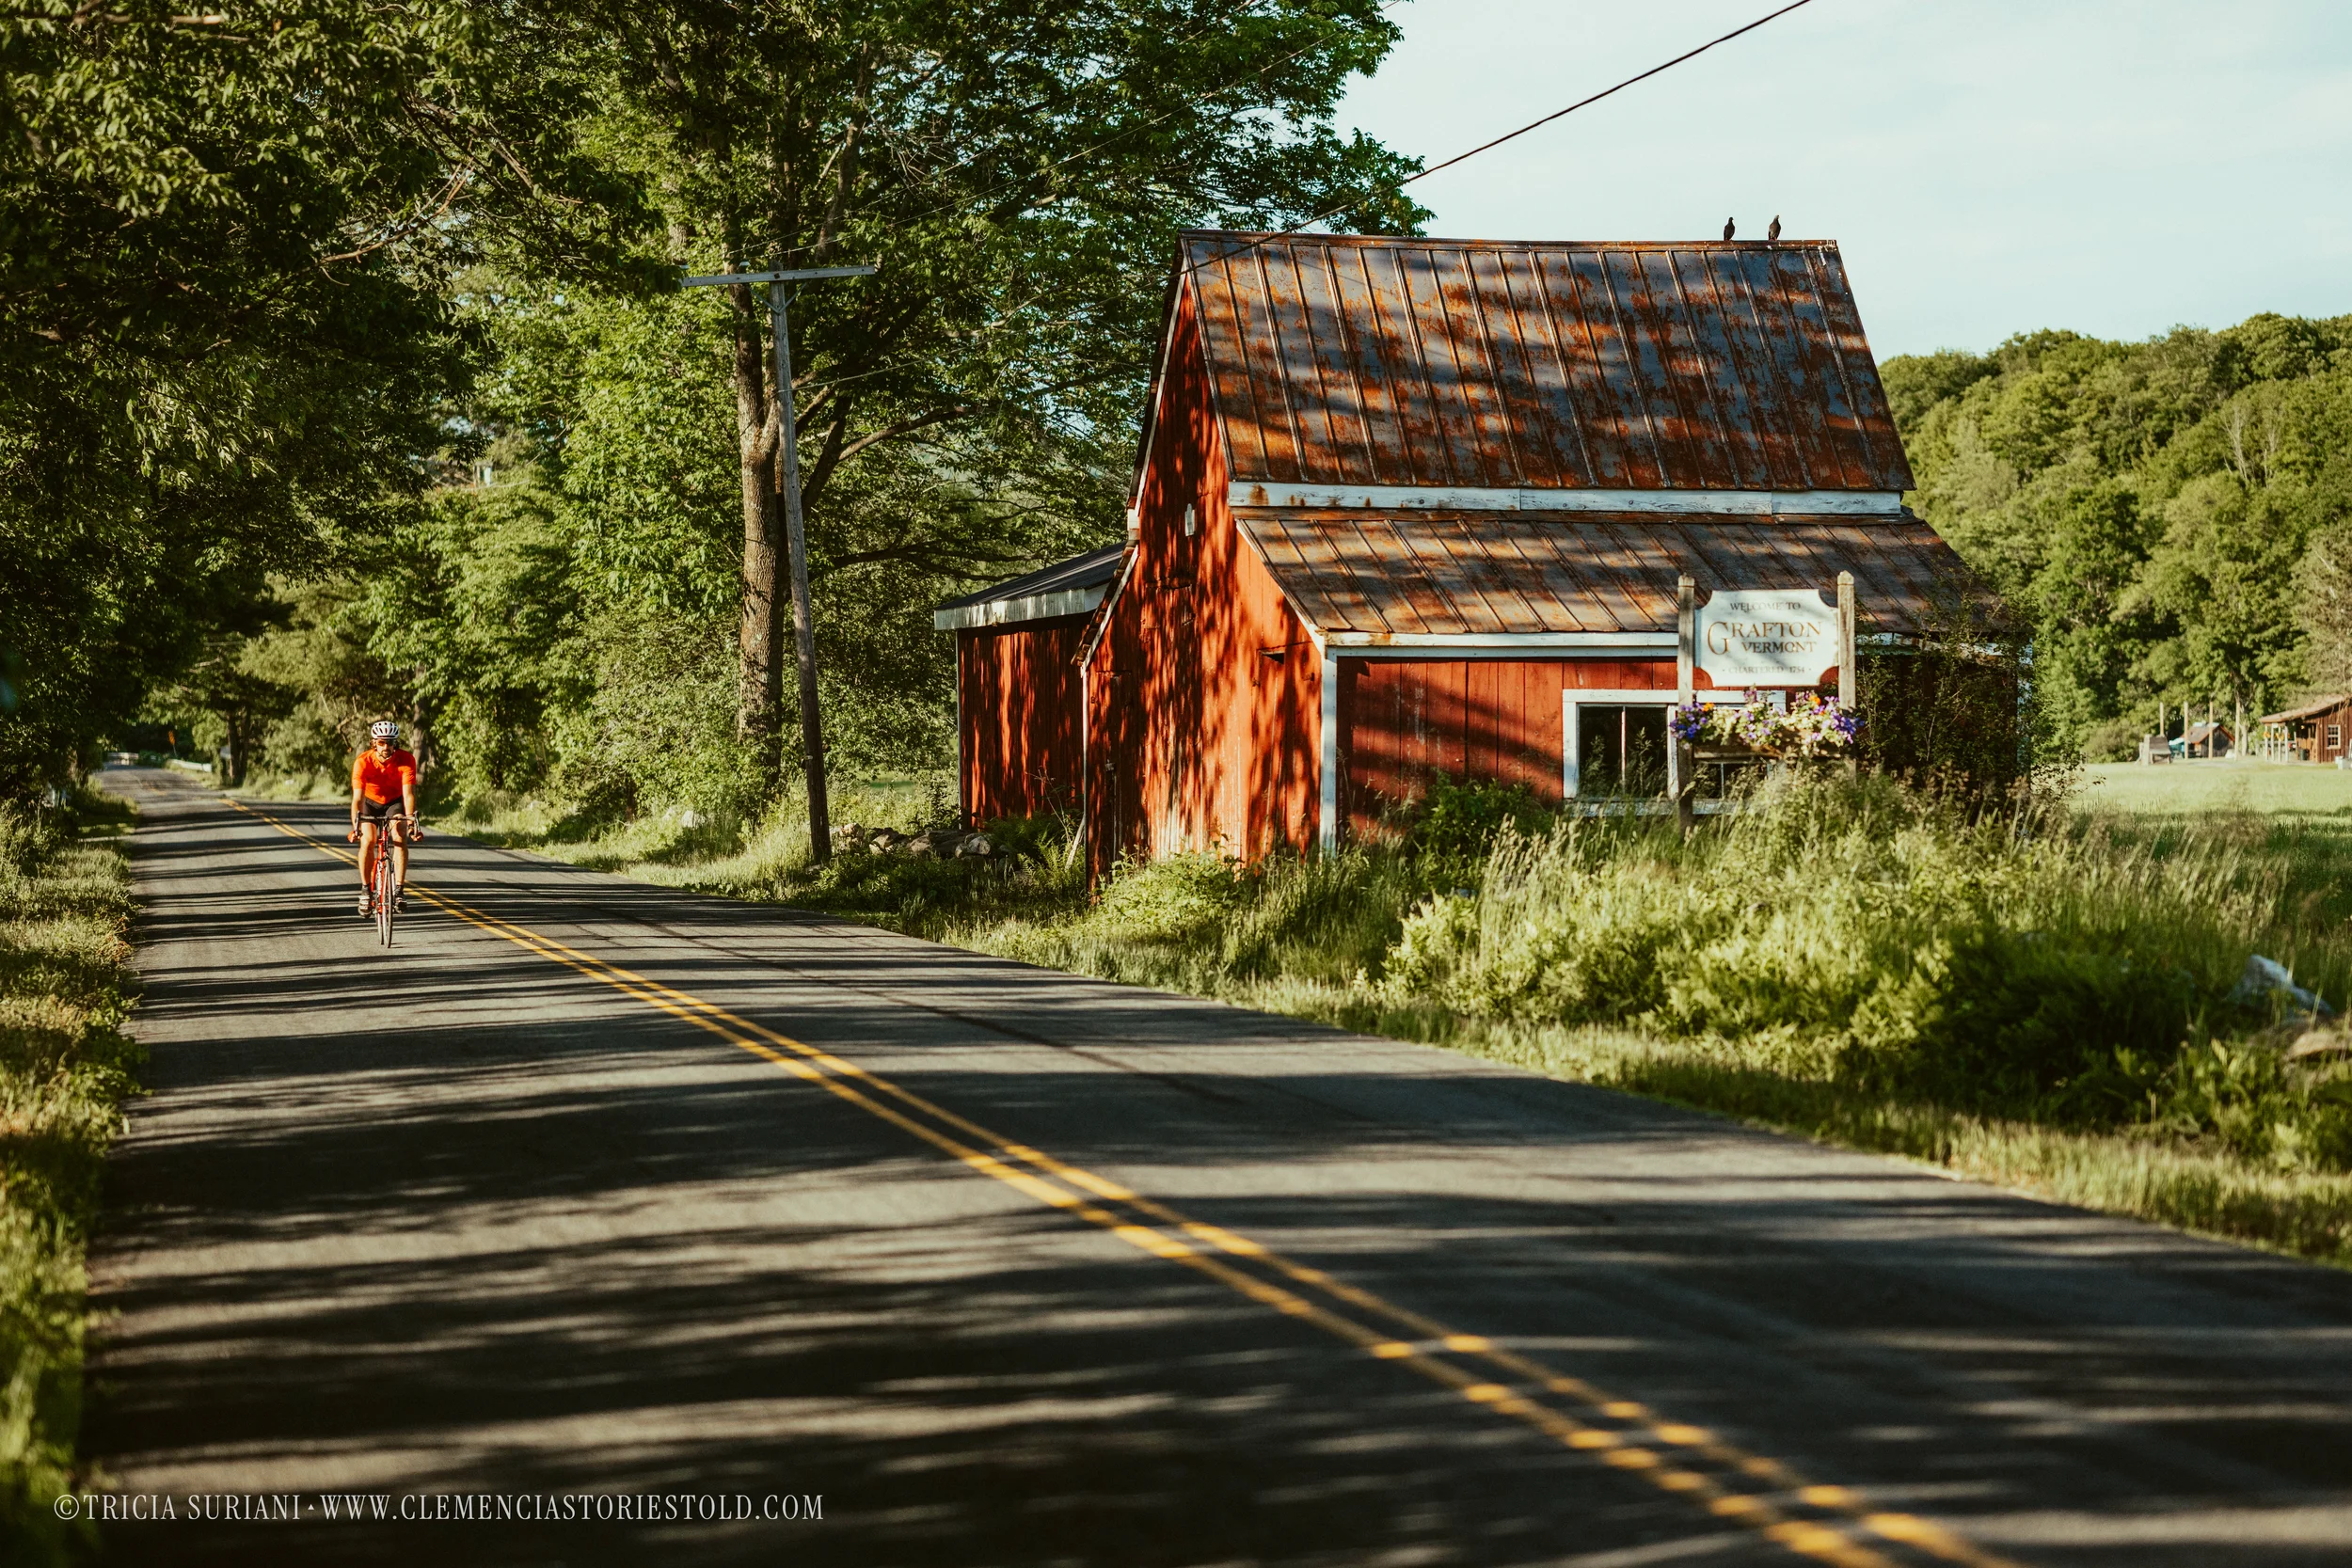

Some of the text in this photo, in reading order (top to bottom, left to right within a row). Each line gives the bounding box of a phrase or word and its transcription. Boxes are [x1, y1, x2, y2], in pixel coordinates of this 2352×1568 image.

[1729, 601, 1802, 611] WELCOME TO
[1707, 621, 1821, 656] GRAFTON
[1742, 641, 1817, 654] VERMONT
